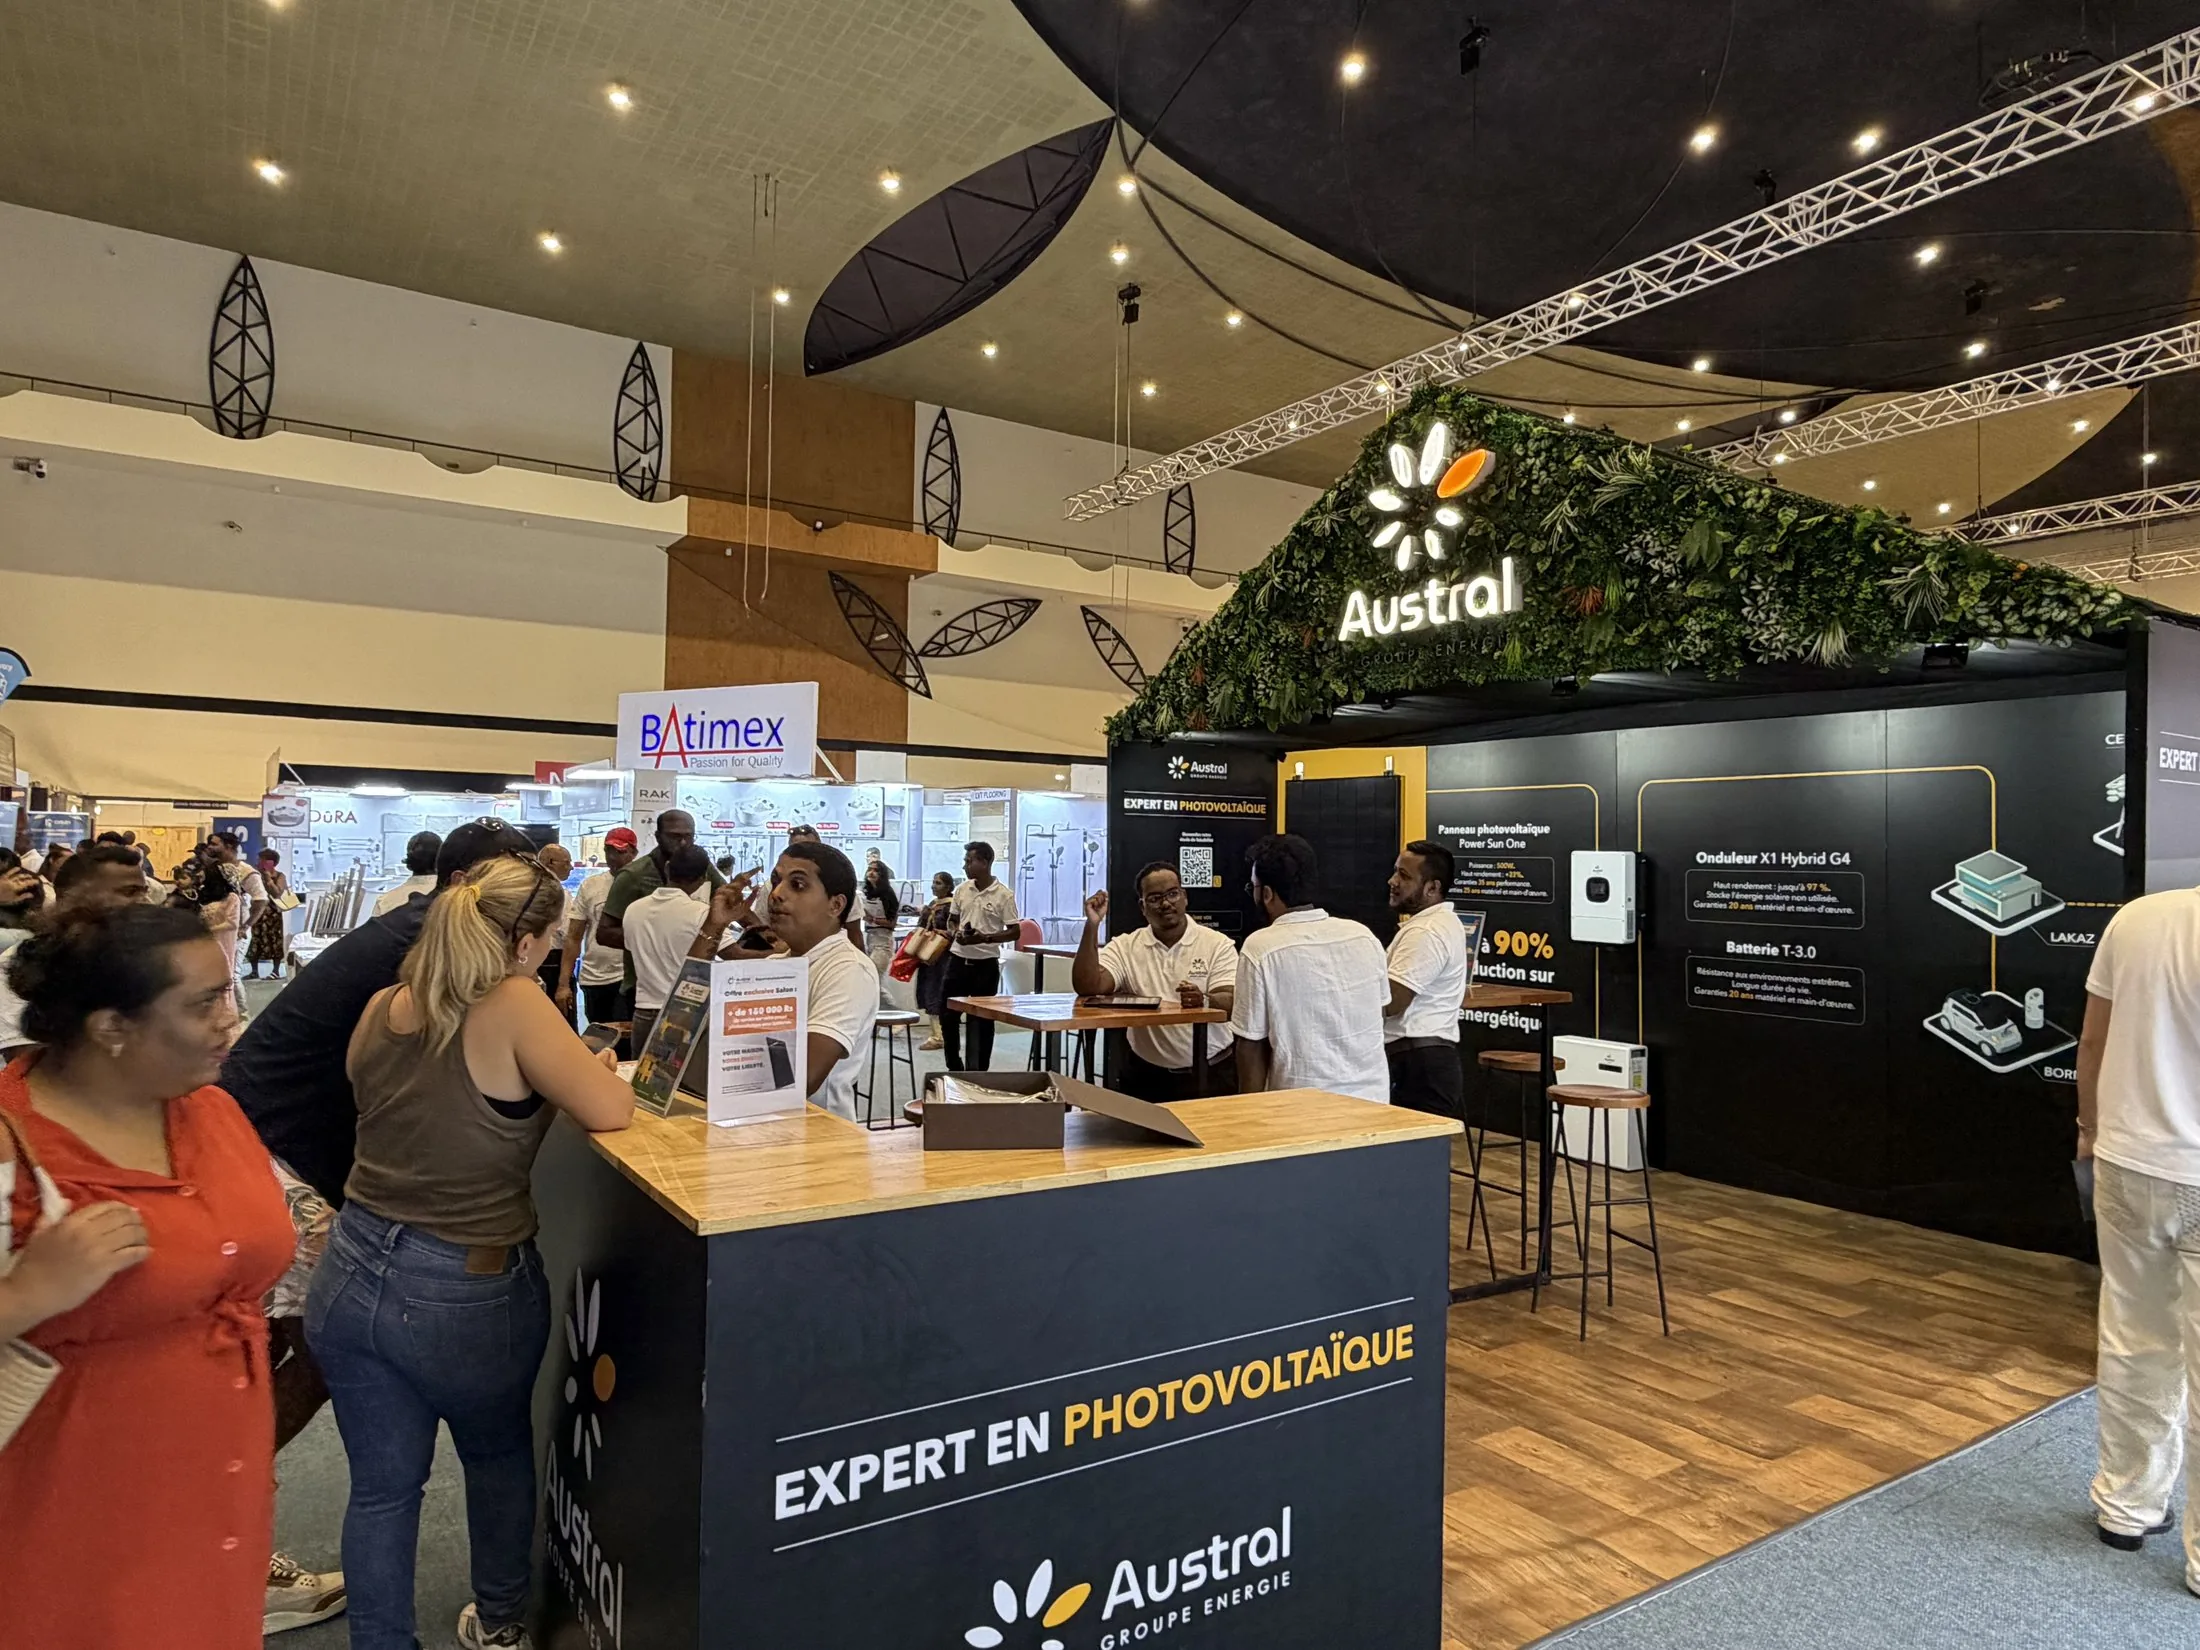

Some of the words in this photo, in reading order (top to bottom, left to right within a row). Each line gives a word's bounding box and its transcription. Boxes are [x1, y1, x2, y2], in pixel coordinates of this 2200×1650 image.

[1338, 556, 1517, 641] Austral
[690, 756, 728, 769] Passion
[731, 755, 744, 767] for
[747, 755, 783, 769] Quality
[1190, 761, 1227, 774] Austral
[2160, 747, 2198, 772] EXPERT
[639, 789, 670, 799] RAK
[1123, 798, 1162, 810] EXPERT
[1163, 800, 1178, 811] EN
[1179, 801, 1267, 814] PHOTOVOLTAÏQUE
[1438, 824, 1475, 835] Panneau
[1477, 823, 1551, 837] photovoltaïque
[1459, 838, 1485, 848] Power
[1487, 838, 1504, 849] Sun
[1506, 838, 1527, 849] One
[1695, 851, 1758, 864] Onduleur
[1760, 852, 1777, 864] X1
[1781, 852, 1826, 868] Hybrid
[1829, 852, 1851, 865] G4
[1713, 881, 1730, 889] Haut
[1731, 882, 1772, 890] rendement
[1806, 883, 1818, 891] 97
[1706, 891, 1730, 899] Stocke
[1764, 893, 1790, 901] solaire
[1693, 901, 1727, 909] Garanties
[1754, 902, 1785, 912] matériel
[1481, 938, 1491, 954] à
[1493, 930, 1555, 959] 90%
[2050, 932, 2096, 945] LAKAZ
[1726, 941, 1780, 957] Batterie
[1781, 944, 1817, 959] T-3.0
[1529, 970, 1555, 983] sur
[1696, 967, 1734, 978] Résistance
[1735, 971, 1748, 979] aux
[1749, 972, 1811, 985] environnements
[775, 986, 793, 994] Salon
[1731, 980, 1760, 991] Longue
[1760, 982, 1783, 992] durée
[1785, 985, 1796, 993] de
[1694, 986, 1728, 997] Garanties
[1728, 989, 1740, 999] 20
[1740, 992, 1754, 1000] ans
[1755, 991, 1786, 1003] matériel
[1787, 995, 1796, 1004] et
[1458, 1008, 1543, 1034] energétiqu
[775, 1428, 975, 1521] EXPERT
[987, 1411, 1049, 1466] EN
[1064, 1324, 1414, 1446] PHOTOVOLTAÏQUE
[544, 1440, 624, 1650] Austral
[1101, 1506, 1291, 1621] Austral
[1100, 1605, 1192, 1650] GROUPE
[1204, 1571, 1291, 1615] ENERGIE
